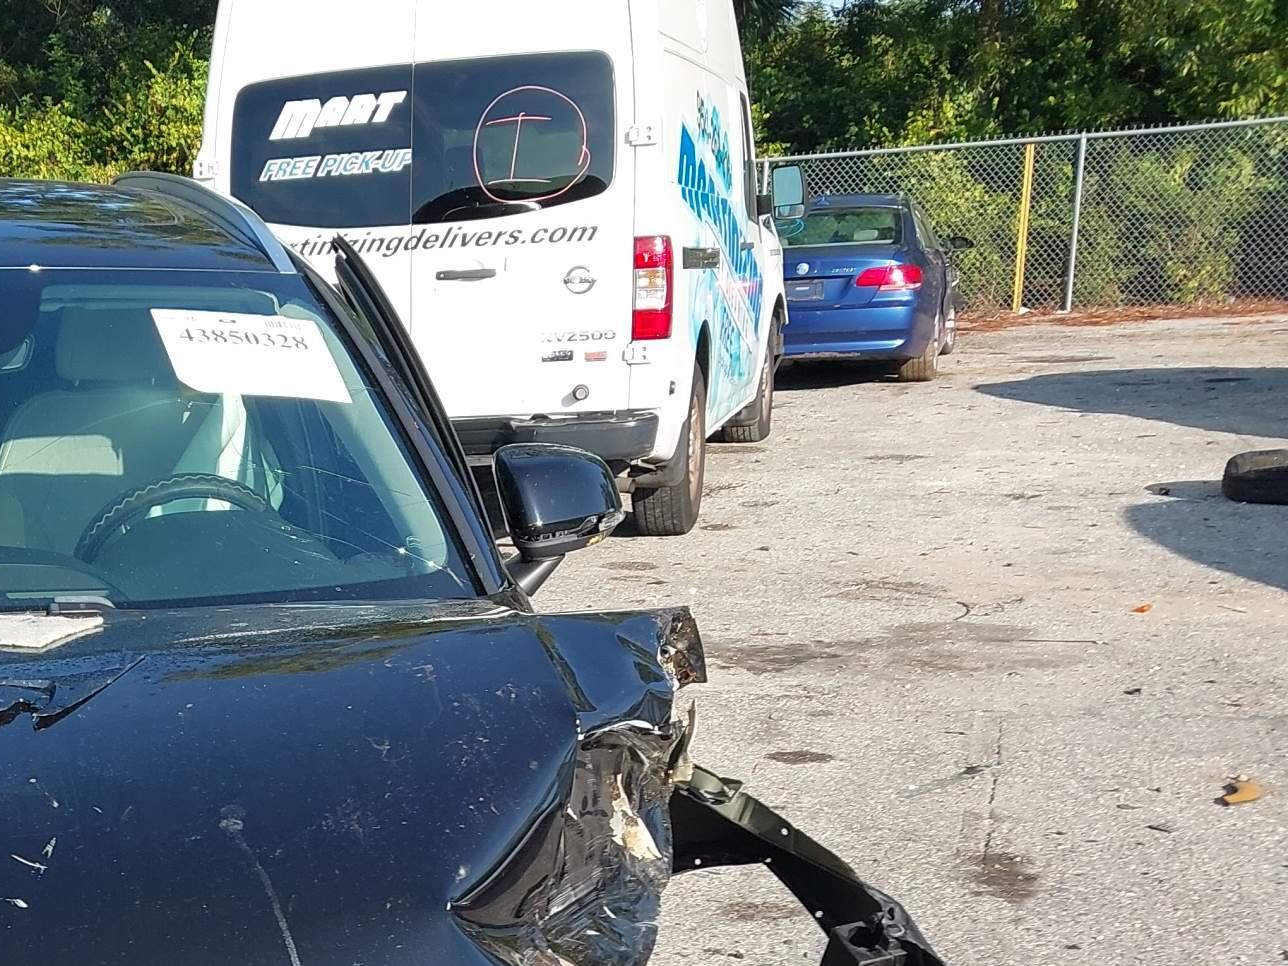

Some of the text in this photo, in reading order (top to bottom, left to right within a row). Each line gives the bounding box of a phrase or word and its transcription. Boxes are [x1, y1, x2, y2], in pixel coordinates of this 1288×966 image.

[268, 90, 408, 140] MART
[259, 148, 412, 182] FREE PICK-UP
[179, 327, 309, 350] 43850328
